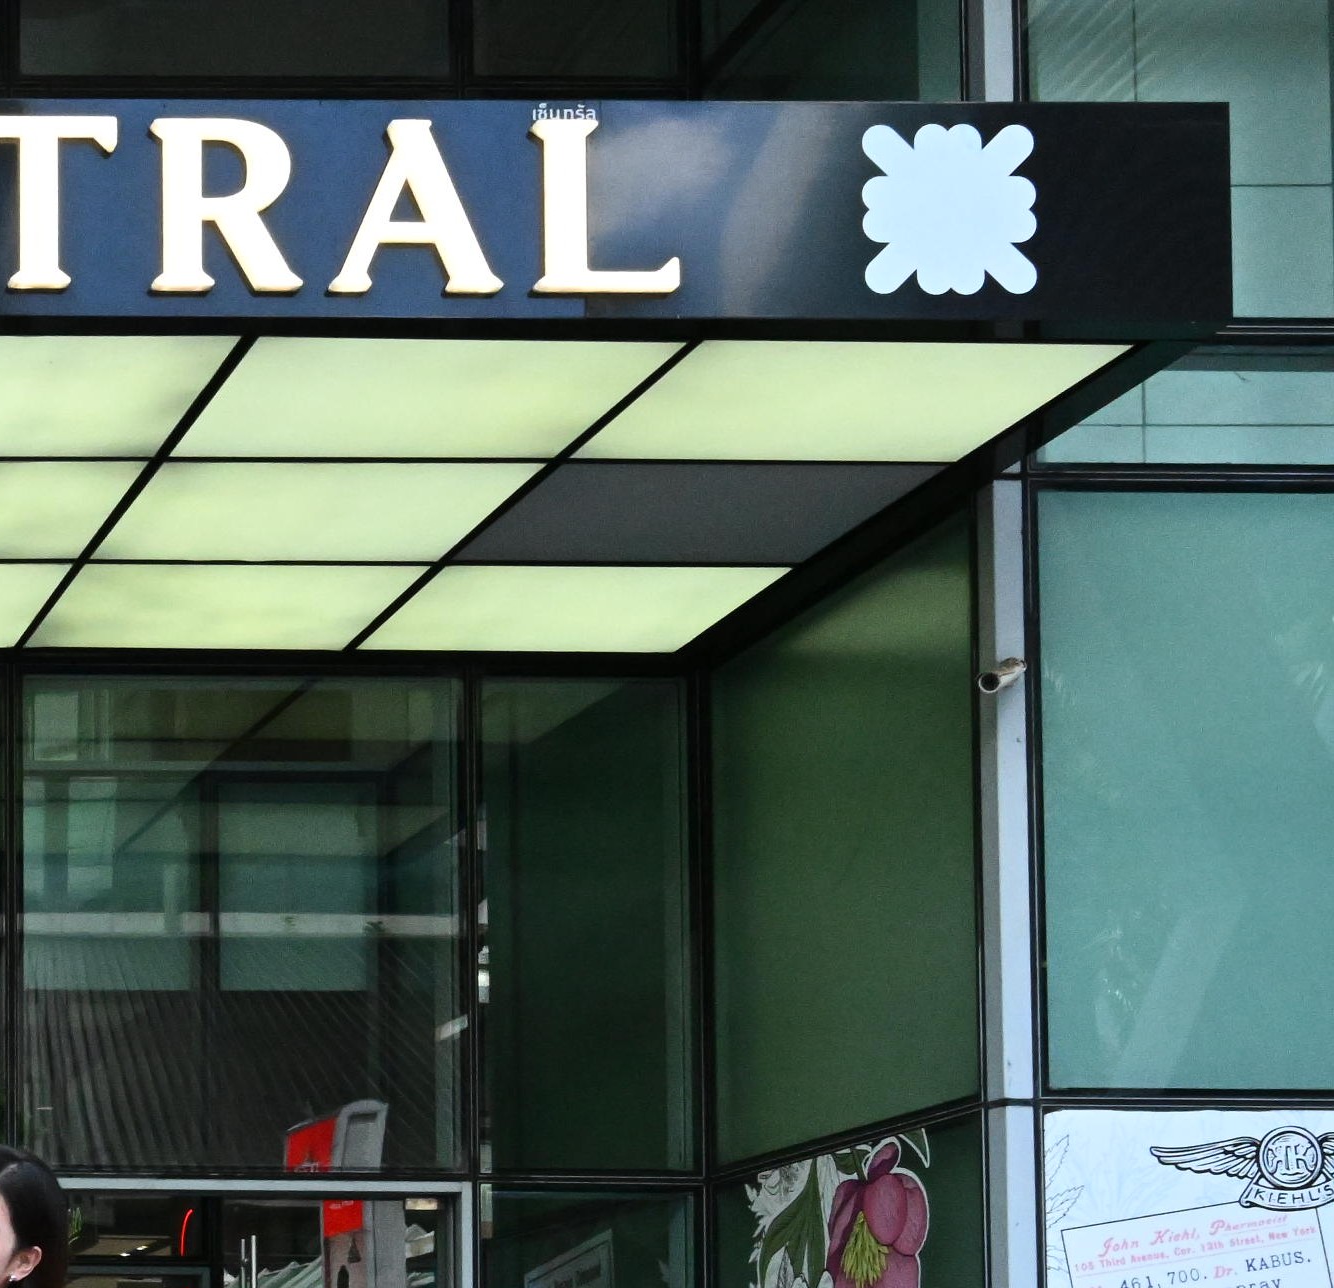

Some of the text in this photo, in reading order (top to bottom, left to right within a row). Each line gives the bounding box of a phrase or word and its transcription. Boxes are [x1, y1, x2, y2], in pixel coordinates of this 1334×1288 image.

[532, 102, 596, 120] เซ็นทรัล
[1254, 1185, 1334, 1205] KIEHL'S
[1097, 1236, 1139, 1258] John
[1150, 1229, 1200, 1246] Kiehl,
[1098, 1256, 1126, 1269] Third
[1229, 1235, 1264, 1249] Street,
[1269, 1230, 1289, 1241] New
[1293, 1225, 1317, 1237] York
[1213, 1265, 1238, 1279] Dr.
[1245, 1250, 1311, 1273] KABUS.
